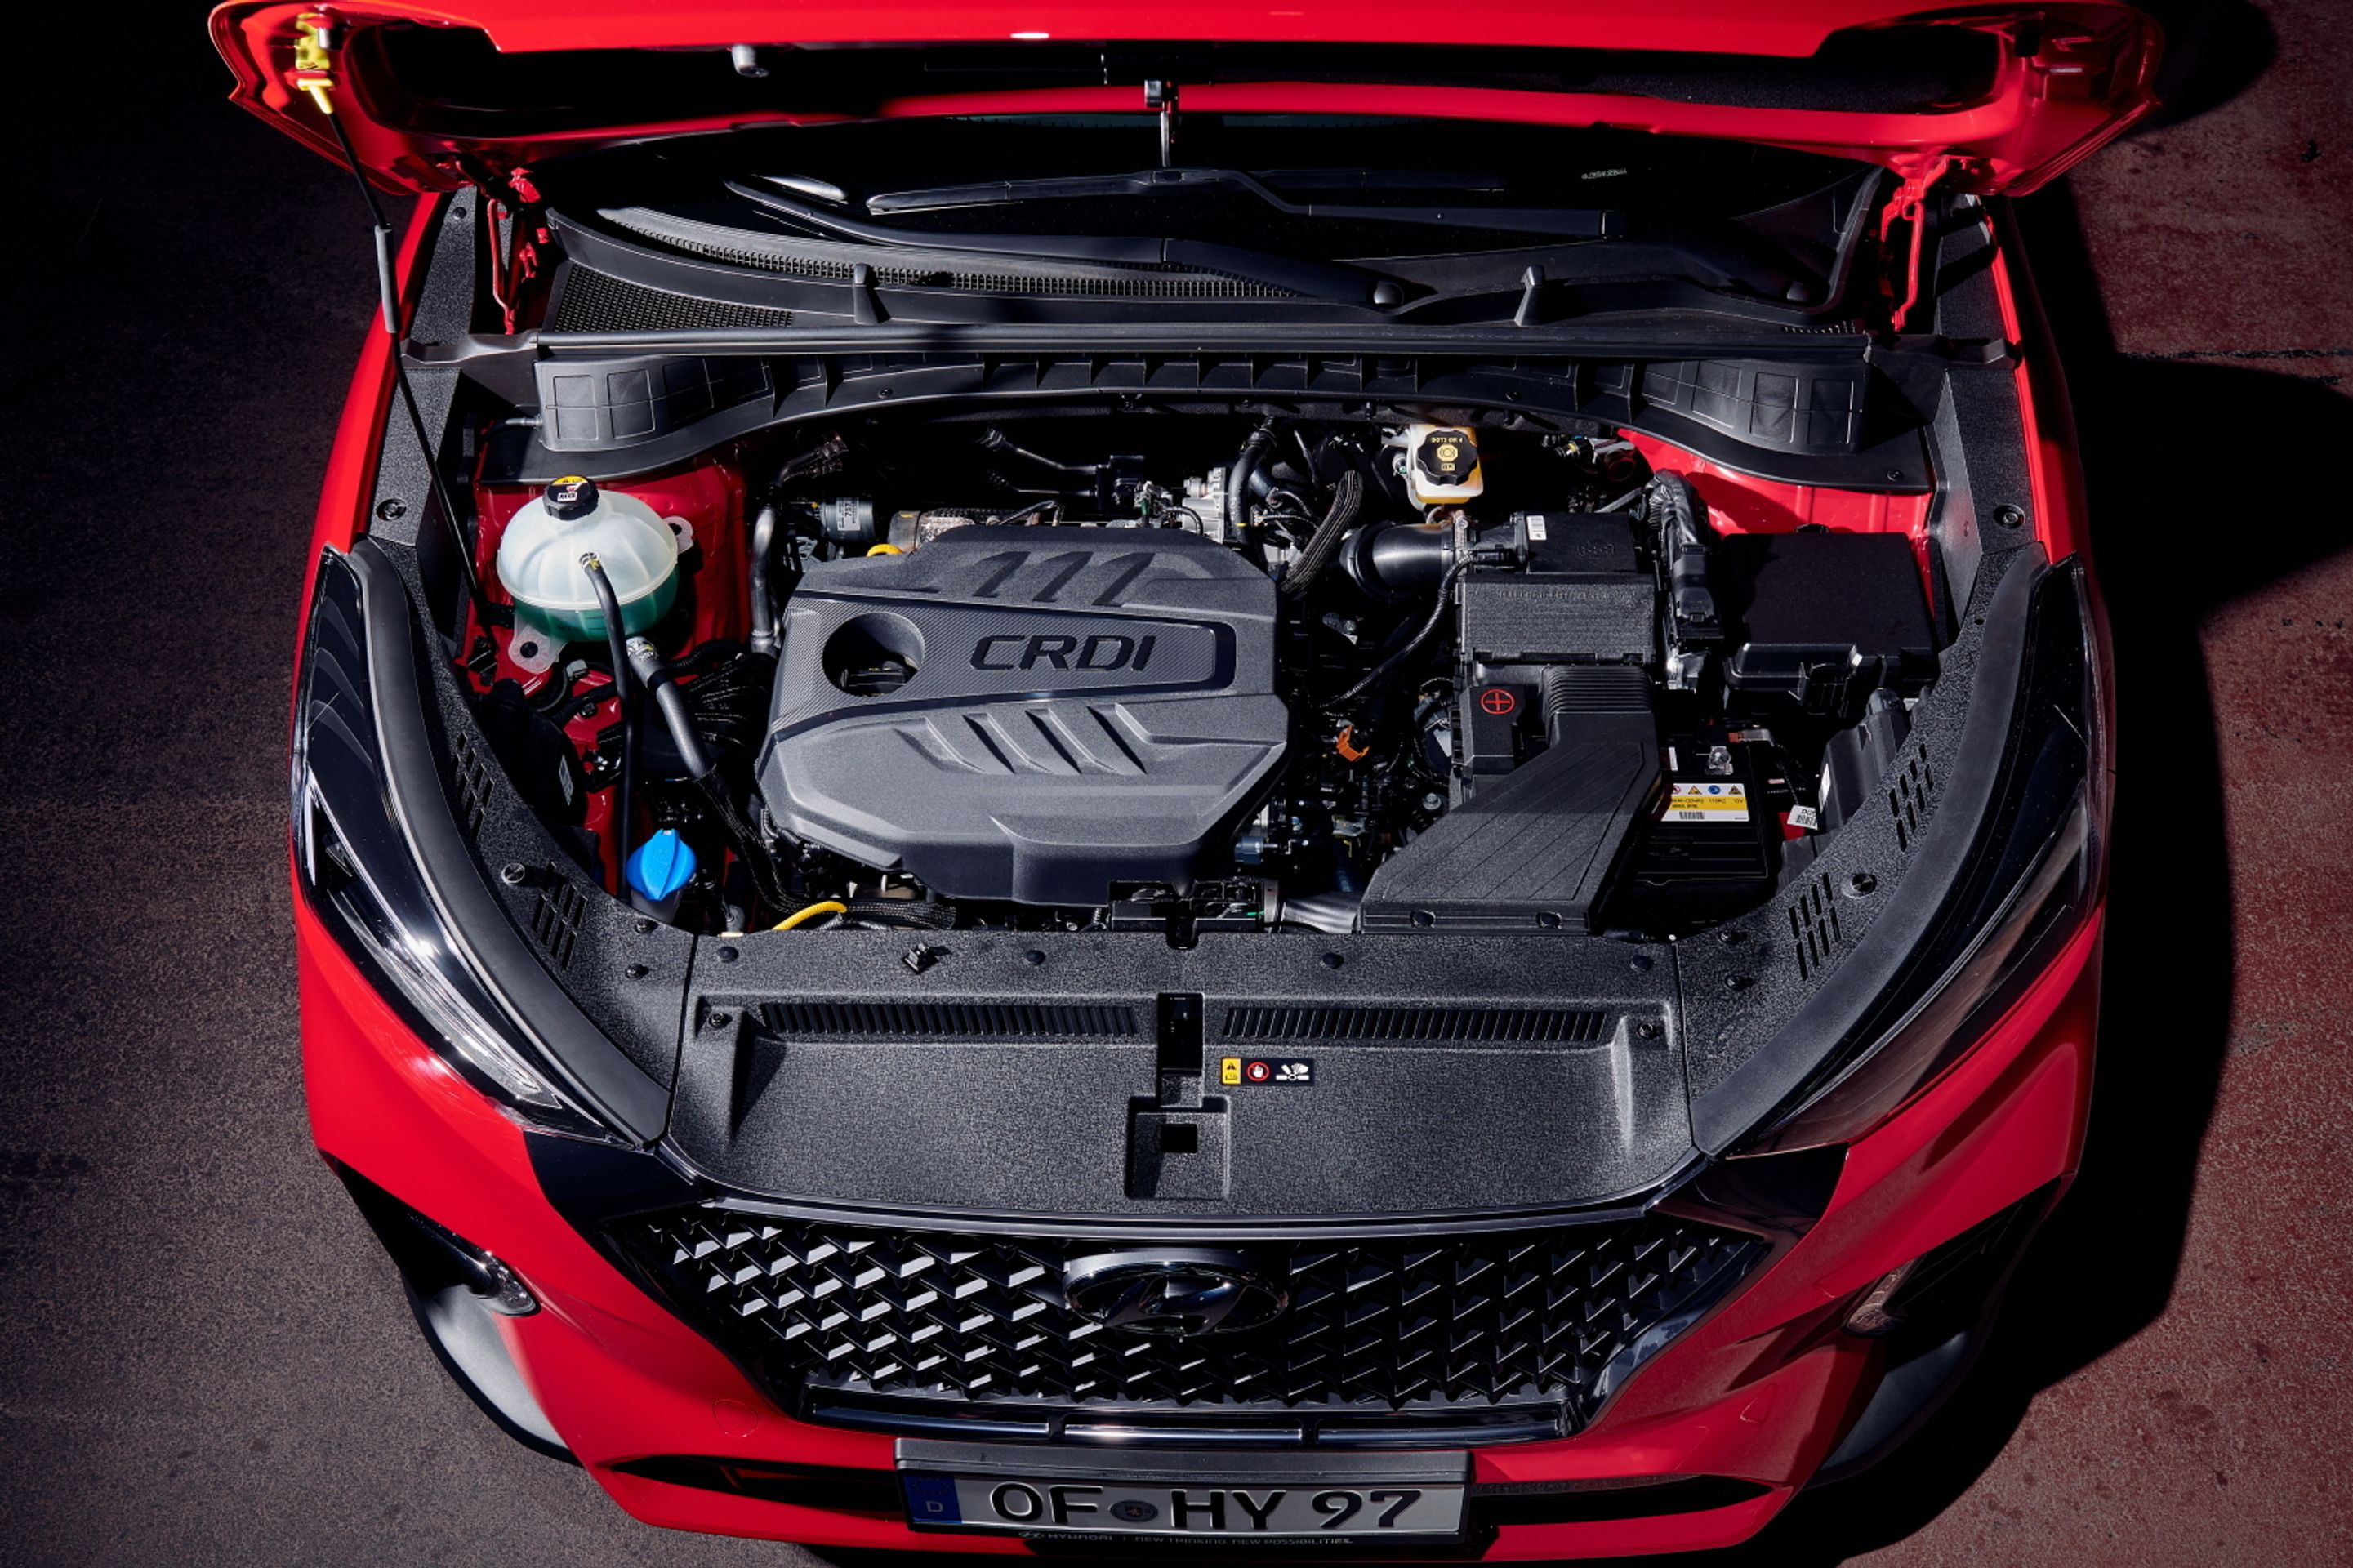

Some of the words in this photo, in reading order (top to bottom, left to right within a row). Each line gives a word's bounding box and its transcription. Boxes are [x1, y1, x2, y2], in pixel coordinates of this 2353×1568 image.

[969, 635, 1156, 671] CRDI
[926, 1500, 943, 1512] D
[990, 1481, 1103, 1525] OF
[1170, 1489, 1287, 1530] HY
[1312, 1489, 1423, 1529] 97
[1048, 1533, 1112, 1541] HYUNDAI
